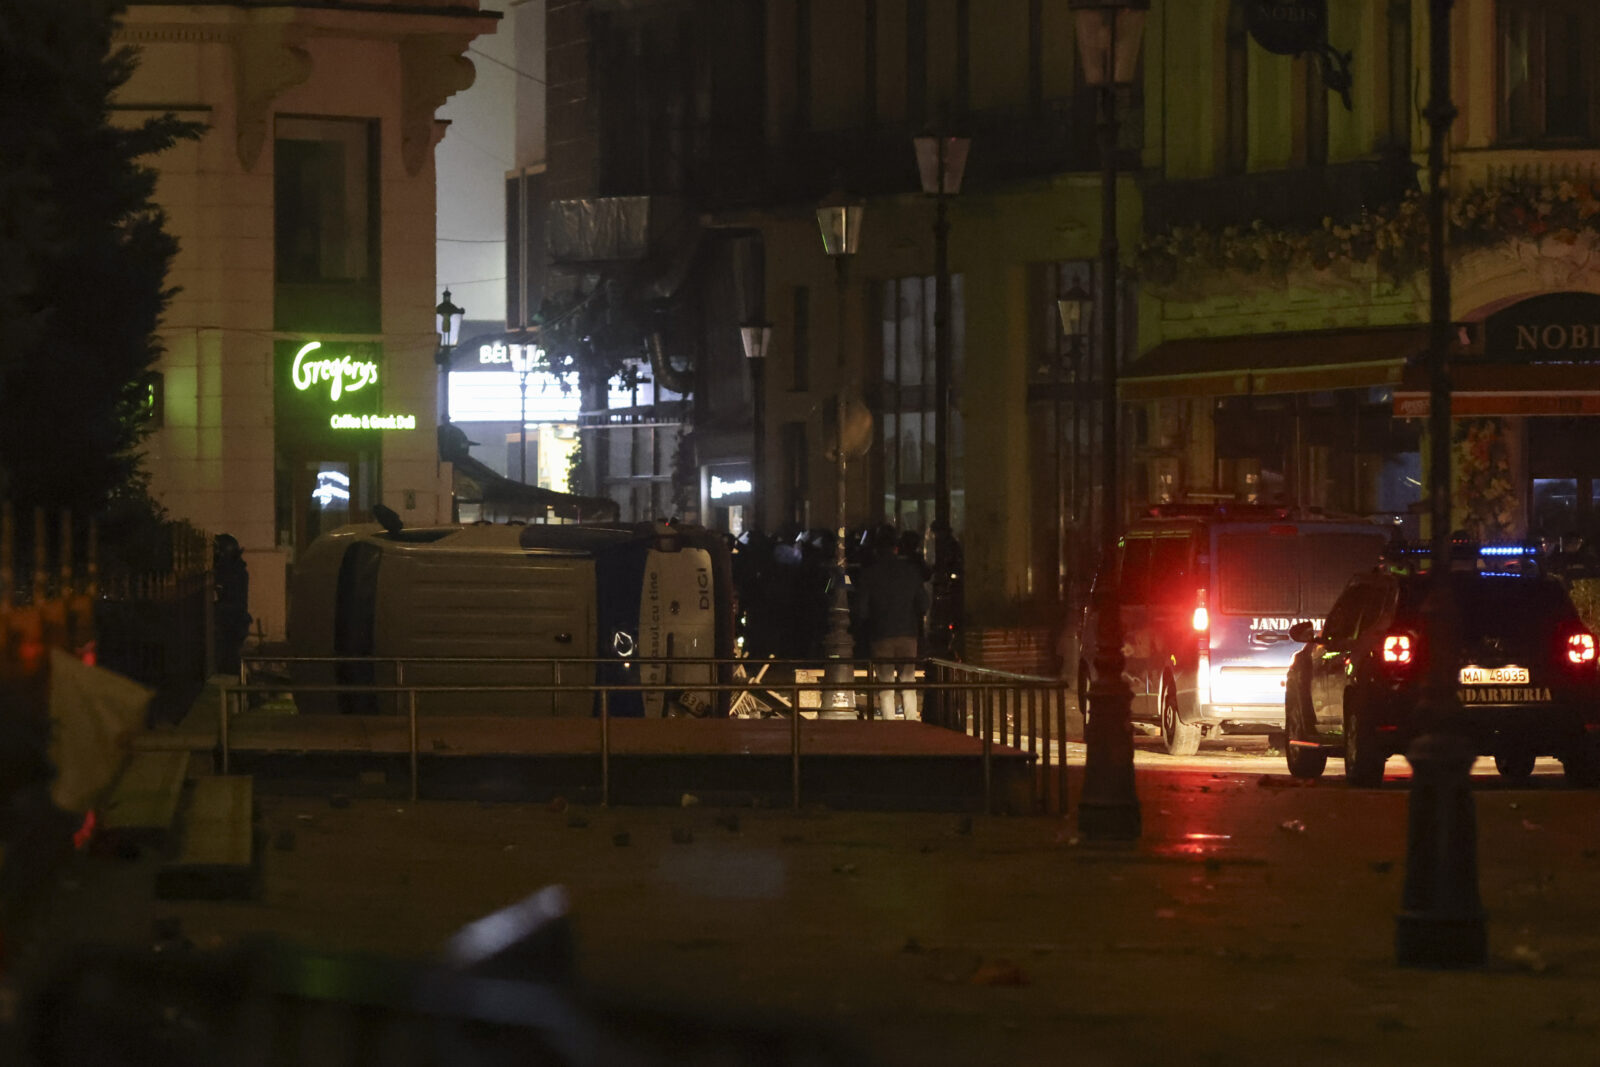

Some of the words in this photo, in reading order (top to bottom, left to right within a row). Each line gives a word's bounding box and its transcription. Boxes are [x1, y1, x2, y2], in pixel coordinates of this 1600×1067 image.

[1258, 4, 1318, 23] NOBIS
[292, 341, 378, 401] Gregorys
[650, 570, 659, 600] tine
[697, 567, 710, 610] DIGI
[651, 604, 659, 623] cu
[1463, 670, 1483, 683] MAI
[1489, 669, 1526, 682] 48035
[1457, 687, 1552, 702] NDARMERIA
